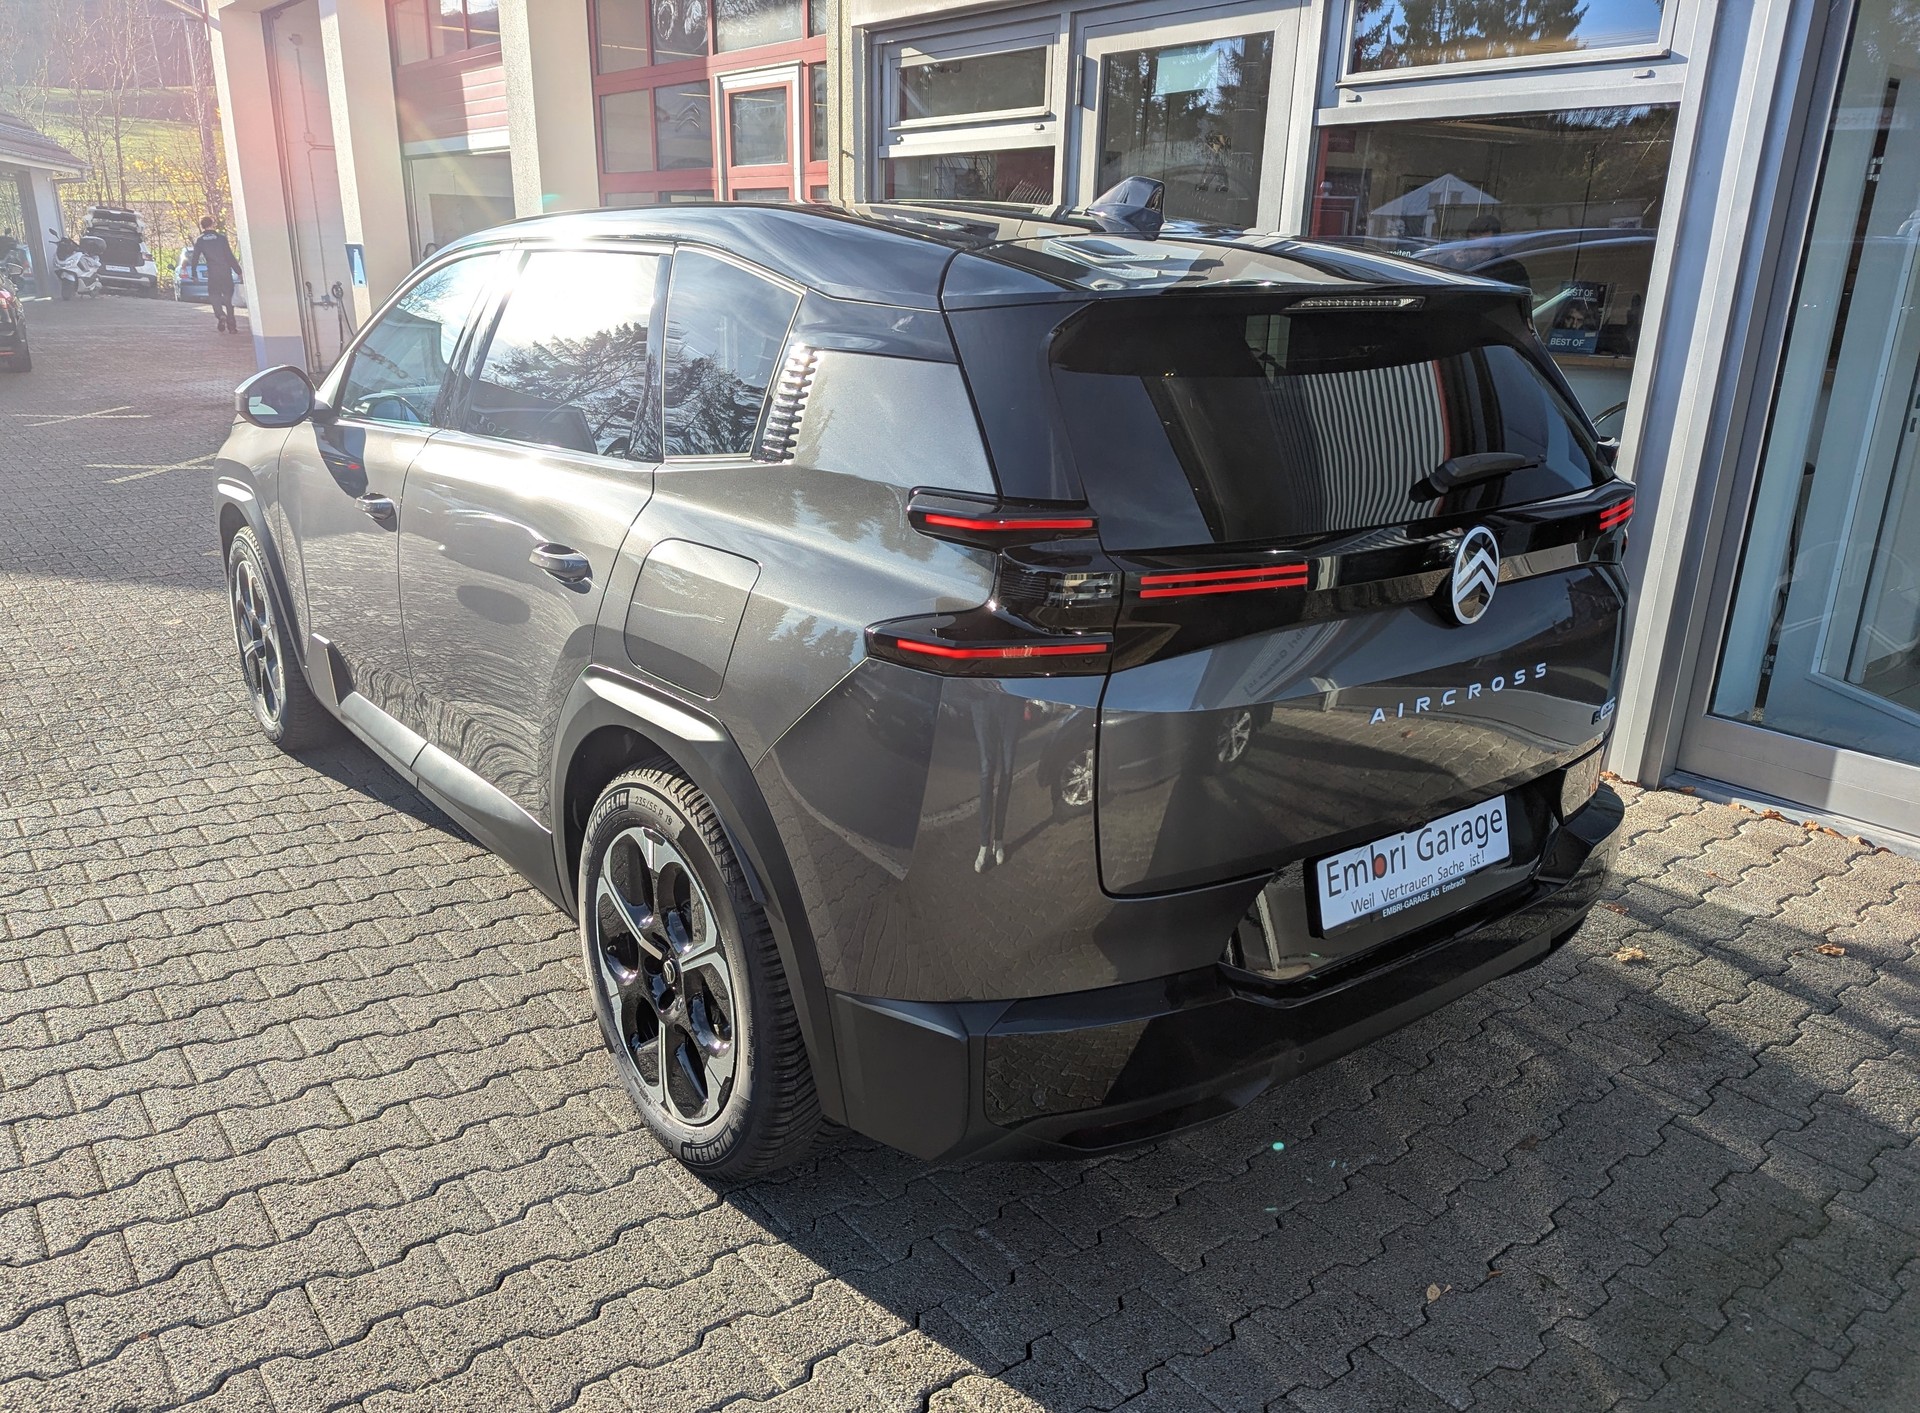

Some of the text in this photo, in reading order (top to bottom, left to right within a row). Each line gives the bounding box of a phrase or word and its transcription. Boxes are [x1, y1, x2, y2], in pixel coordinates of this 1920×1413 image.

[1584, 289, 1594, 297] OF
[1550, 337, 1585, 347] BEST OF
[1369, 662, 1547, 725] AIRCROSS
[588, 792, 628, 842] MICHELIN
[634, 796, 658, 813] 235/55
[665, 814, 673, 826] 19
[1327, 808, 1503, 899] Embri Garage
[1351, 892, 1375, 915] Weil
[1381, 874, 1434, 903] Vertrauen
[1438, 860, 1465, 881] Sache
[1382, 877, 1466, 918] EMBRI-GARAGE AG Embrach
[682, 1127, 735, 1161] MICHELIN
